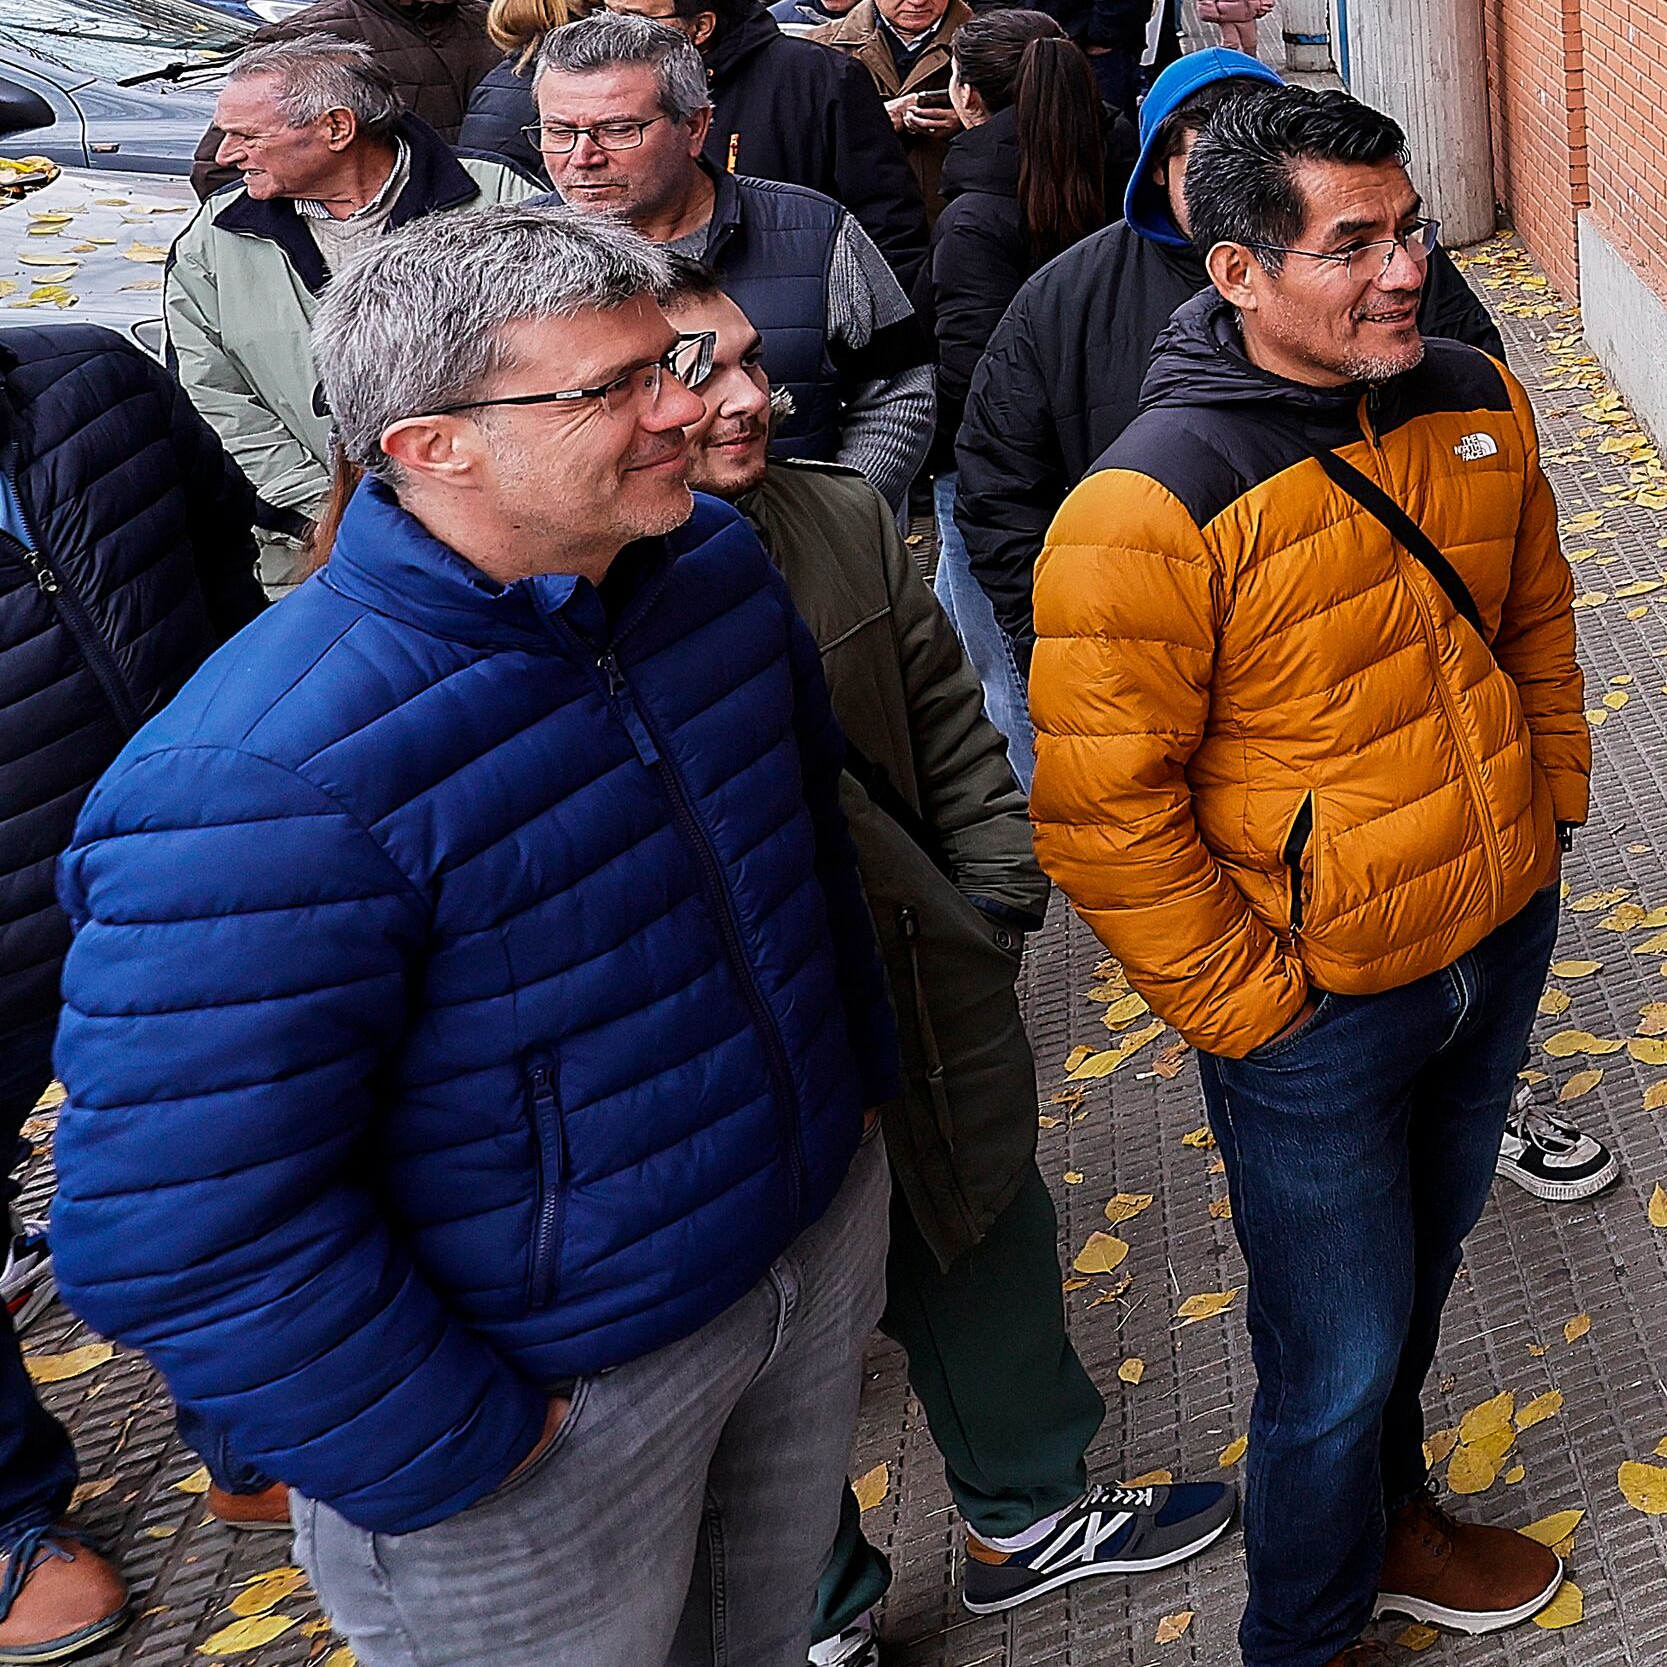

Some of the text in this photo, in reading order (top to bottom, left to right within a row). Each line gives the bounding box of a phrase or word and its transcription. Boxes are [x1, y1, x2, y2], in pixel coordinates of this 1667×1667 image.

[1461, 434, 1478, 446] THE
[1453, 442, 1481, 456] NORTH
[1462, 450, 1484, 462] FACE
